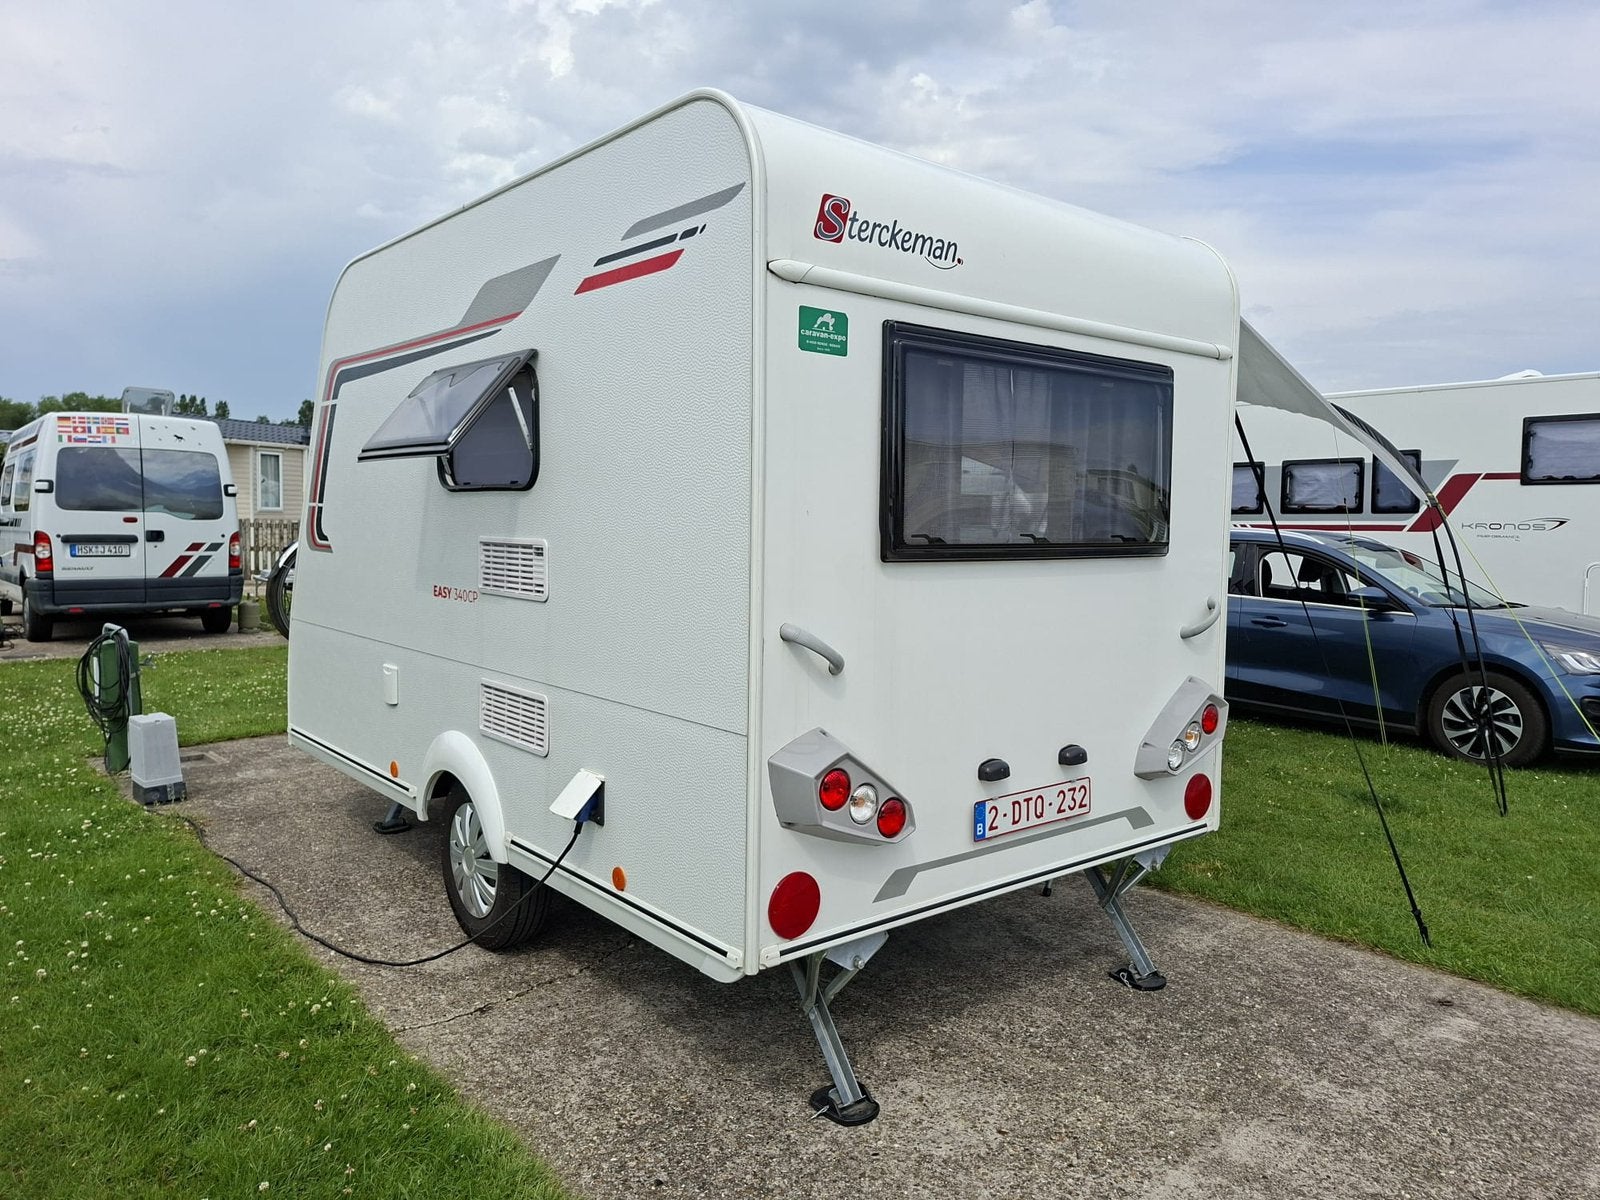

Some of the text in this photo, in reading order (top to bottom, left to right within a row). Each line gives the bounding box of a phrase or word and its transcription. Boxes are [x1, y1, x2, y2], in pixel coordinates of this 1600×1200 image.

[800, 329, 847, 342] caravan-expo
[433, 585, 479, 603] EASY 340CP
[976, 823, 984, 835] B
